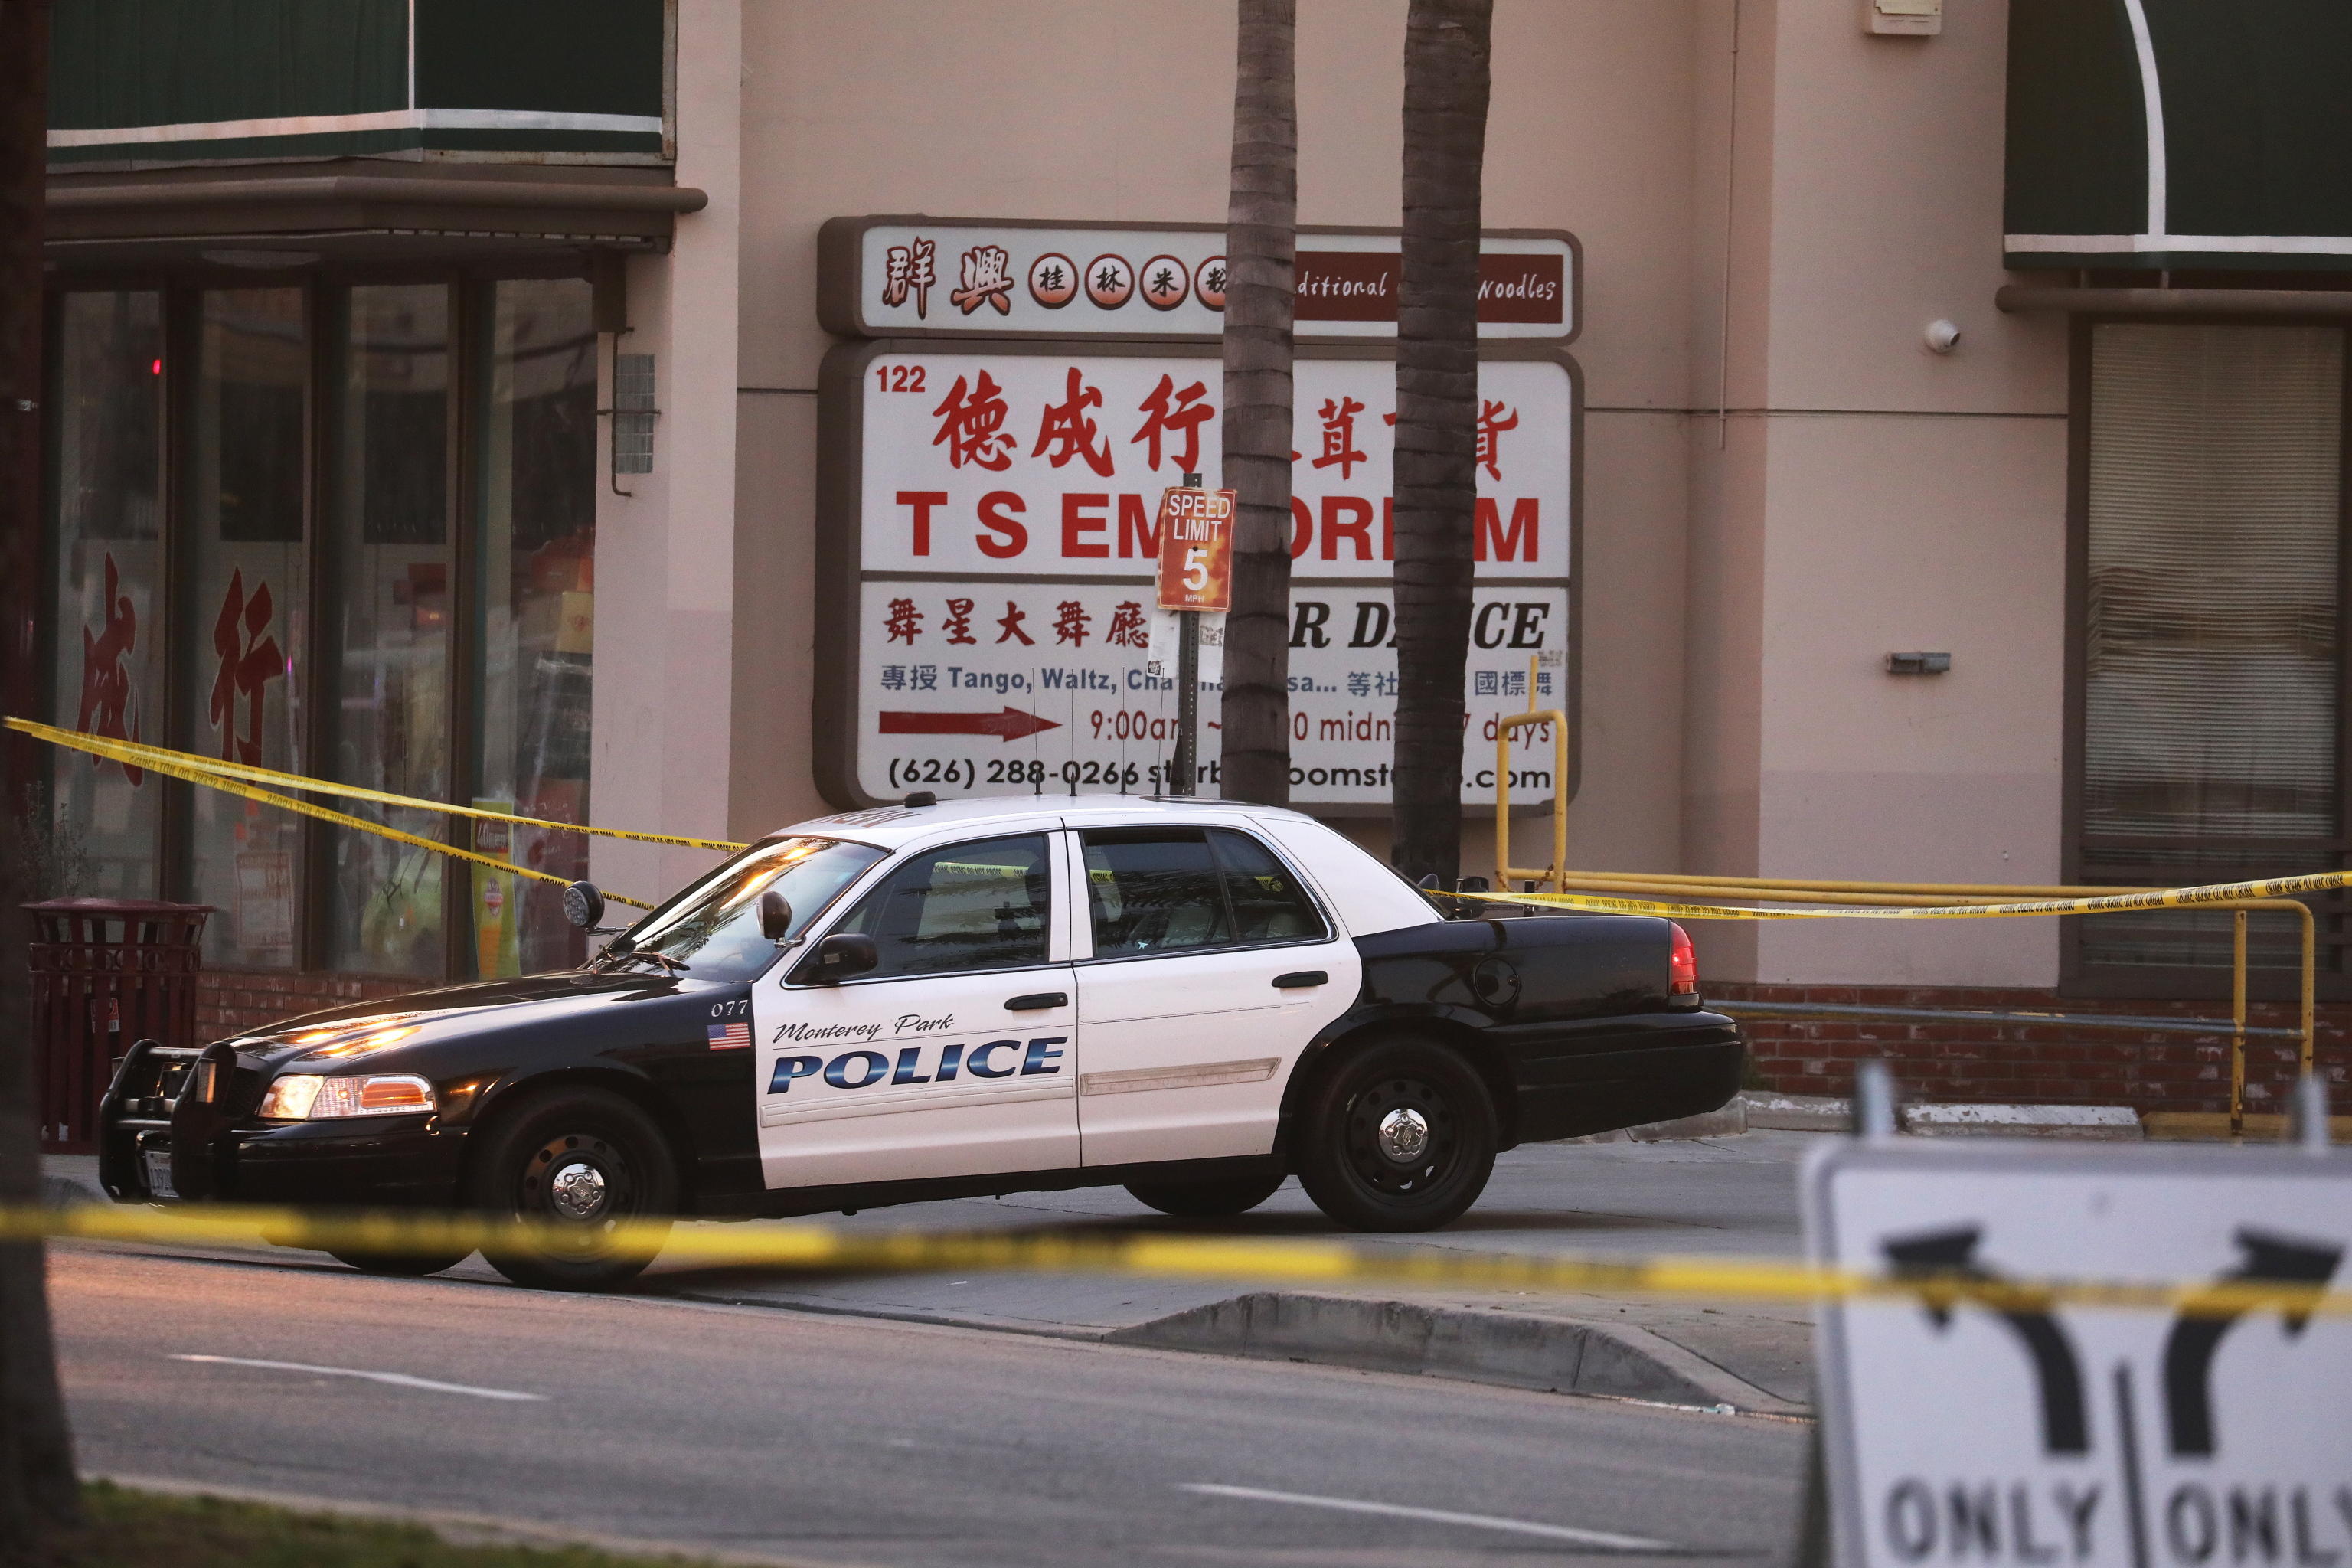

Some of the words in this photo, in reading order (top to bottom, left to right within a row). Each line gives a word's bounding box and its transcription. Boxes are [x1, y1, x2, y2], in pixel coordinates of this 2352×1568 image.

[1295, 270, 1388, 297] ditional
[1478, 273, 1557, 301] Noodles
[876, 365, 926, 393] 122
[932, 366, 1216, 478] 德成行
[1168, 495, 1231, 519] SPEED
[896, 491, 948, 556] T
[975, 490, 1029, 558] S
[1061, 492, 1539, 563] EMRIM
[1173, 518, 1223, 542] LIMIT
[1182, 548, 1208, 591] 5
[1184, 594, 1205, 603] MPH
[1348, 602, 1550, 649] DCE
[880, 664, 938, 691] 專授
[948, 667, 1033, 694] Tango,
[1041, 668, 1117, 695] Waltz,
[1321, 710, 1397, 741] midn
[889, 759, 975, 789] (626)
[986, 760, 1140, 785] 288-0266
[2265, 881, 2282, 895] CRIME
[2285, 880, 2302, 893] SCENE
[2303, 878, 2311, 892] DO
[2313, 876, 2324, 890] NOT
[2325, 874, 2344, 888] CROSS
[710, 998, 750, 1018] 077
[773, 1021, 884, 1044] Monterey
[894, 1013, 956, 1034] Park
[767, 1036, 1069, 1096] POLICE
[1882, 1476, 2104, 1564] ONLY
